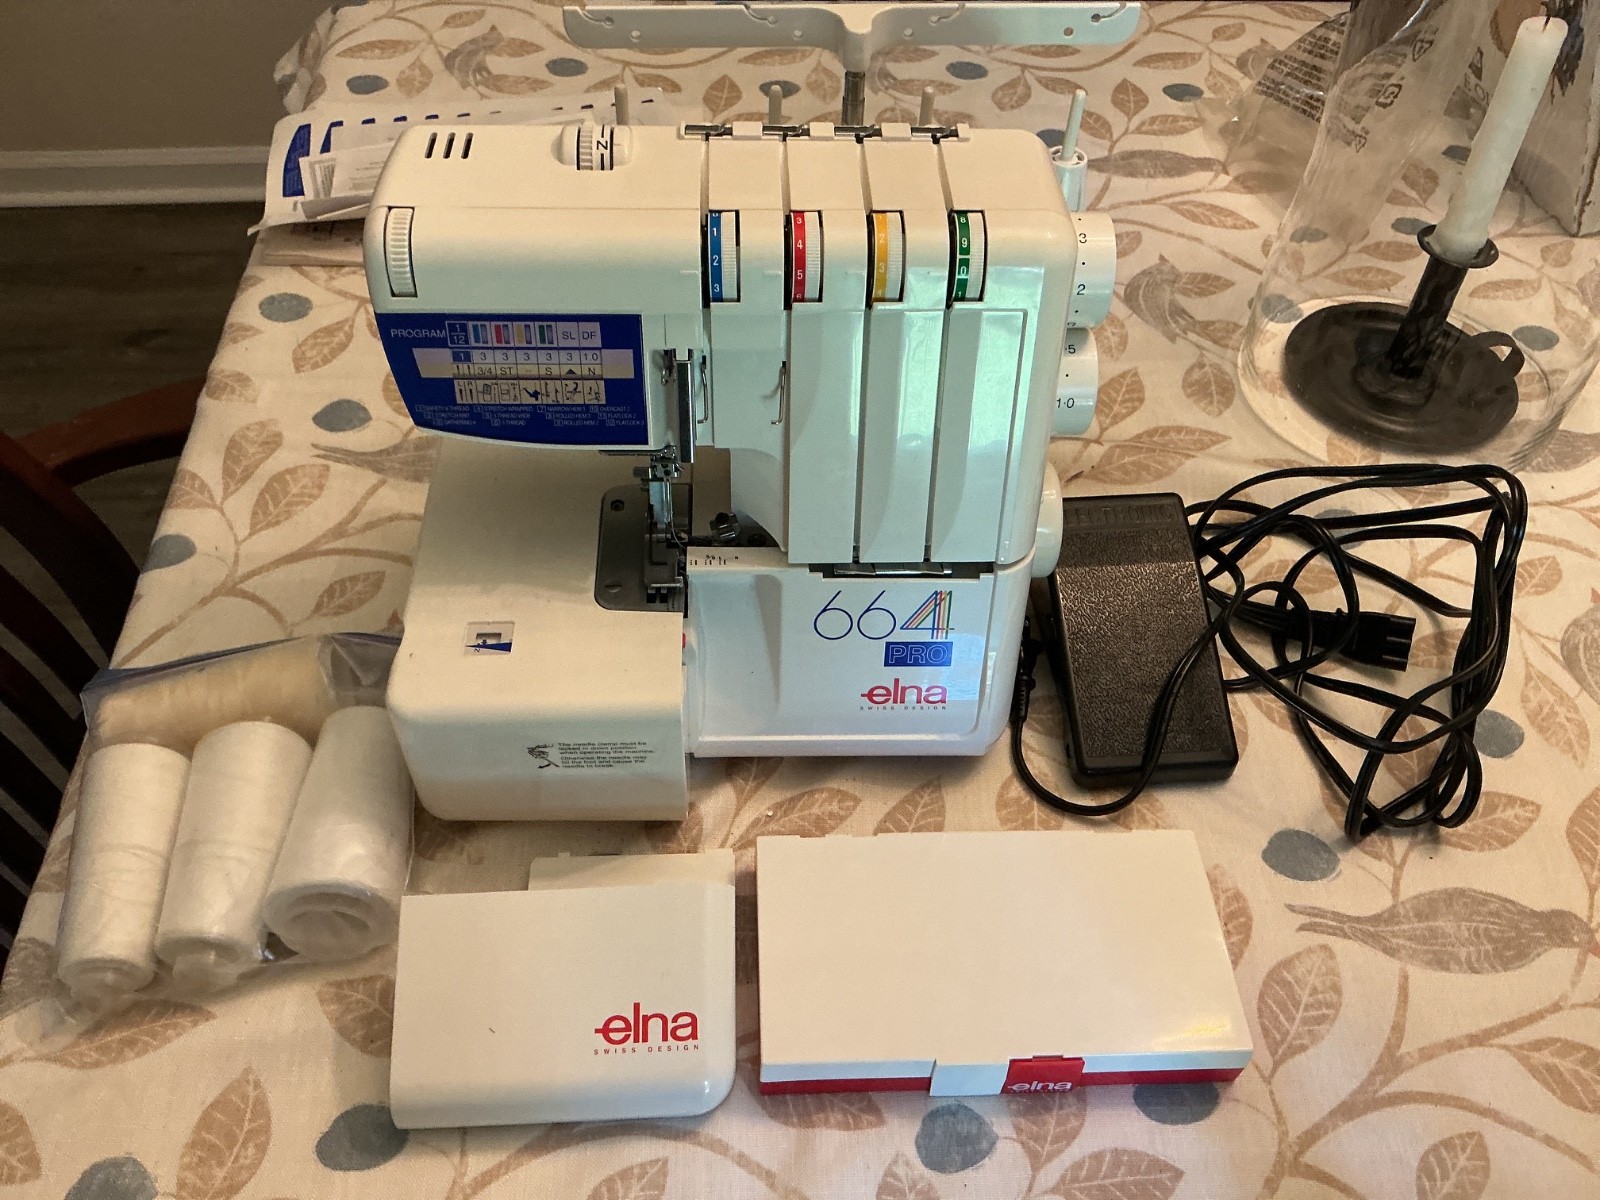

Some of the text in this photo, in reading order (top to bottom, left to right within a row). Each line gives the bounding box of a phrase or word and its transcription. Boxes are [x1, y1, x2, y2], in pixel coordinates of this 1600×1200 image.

[596, 140, 608, 150] N
[796, 217, 802, 225] 3
[712, 227, 717, 236] 1
[880, 233, 885, 244] 2
[961, 238, 968, 248] 9
[1078, 233, 1087, 244] 3
[796, 240, 803, 250] 4
[712, 254, 719, 266] 2
[879, 262, 885, 272] 3
[960, 266, 966, 276] 0
[797, 270, 803, 280] 5
[714, 284, 720, 292] 3
[1076, 284, 1086, 296] 2
[390, 328, 446, 338] PROGRAM
[562, 331, 596, 340] SL DF
[454, 336, 466, 344] 12
[480, 352, 487, 361] 3
[502, 352, 508, 361] 3
[524, 352, 530, 360] 3
[546, 352, 552, 361] 3
[566, 352, 573, 361] 3
[478, 368, 596, 376] 3/4 ST S N
[814, 590, 955, 640] 664
[888, 644, 948, 664] PRO
[861, 678, 947, 704] elna
[594, 1002, 698, 1045] elna
[594, 1044, 699, 1055] SWISS DESIGN
[1008, 1080, 1072, 1090] elna
